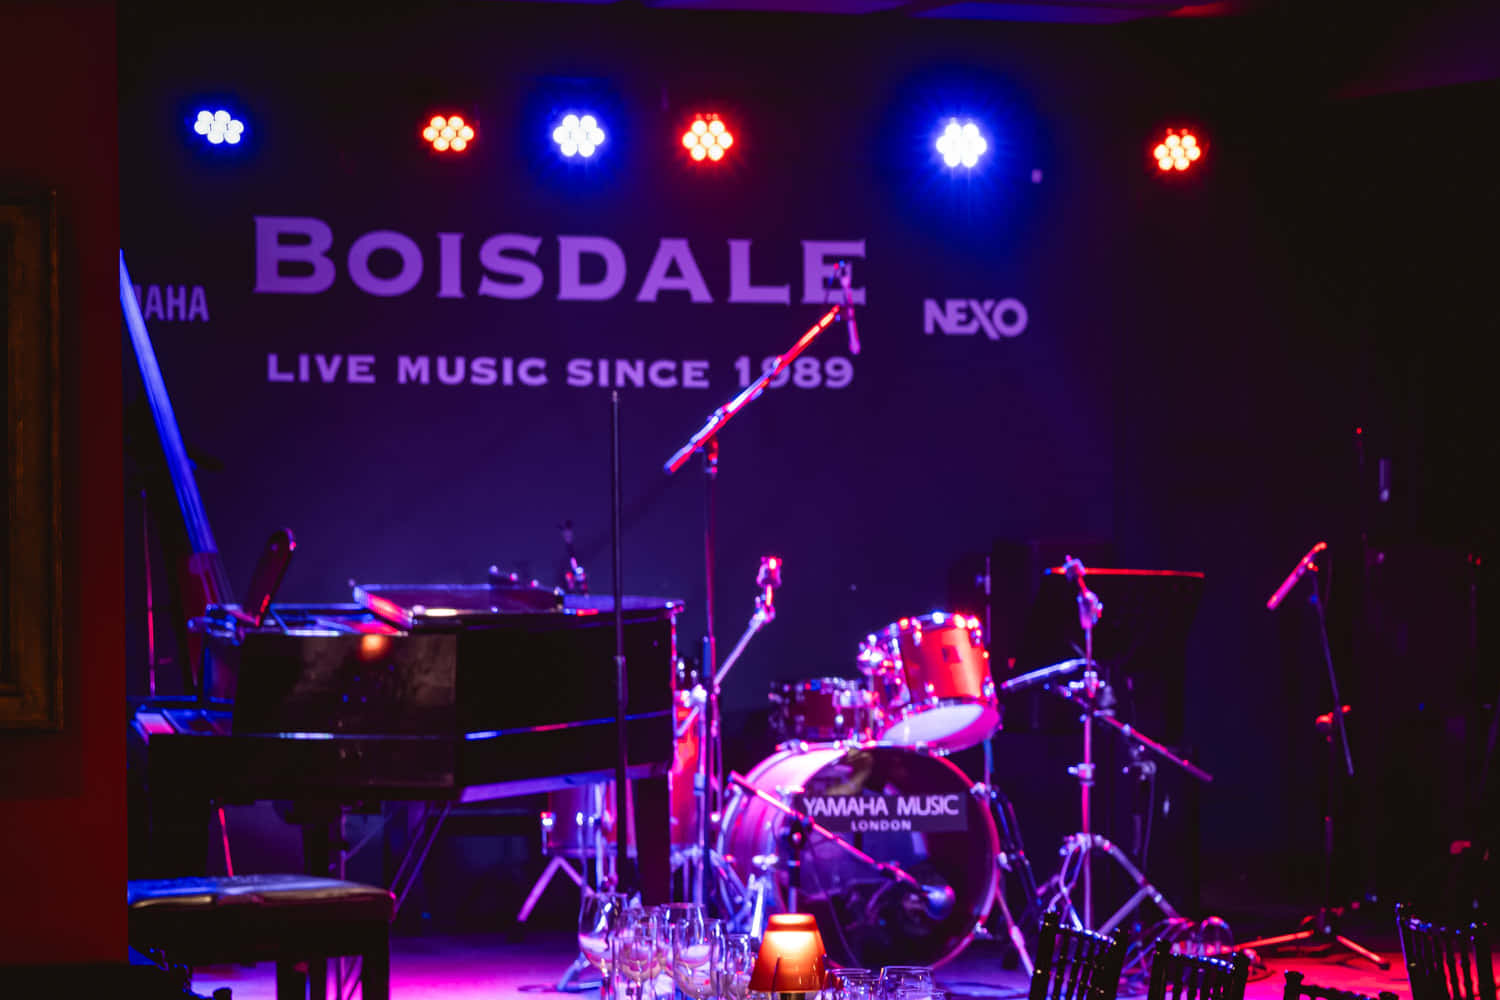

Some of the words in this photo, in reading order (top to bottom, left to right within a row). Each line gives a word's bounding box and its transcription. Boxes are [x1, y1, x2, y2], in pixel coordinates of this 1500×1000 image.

[253, 215, 867, 306] BOISDALE
[923, 298, 1029, 341] NEXO
[266, 352, 377, 384] LIVE
[399, 354, 549, 387] MUSIC
[566, 357, 710, 389] SINCE
[733, 354, 855, 390] 1989
[803, 797, 889, 817] YAMAHA
[896, 795, 960, 816] MUSIC
[850, 819, 912, 832] LONDON
